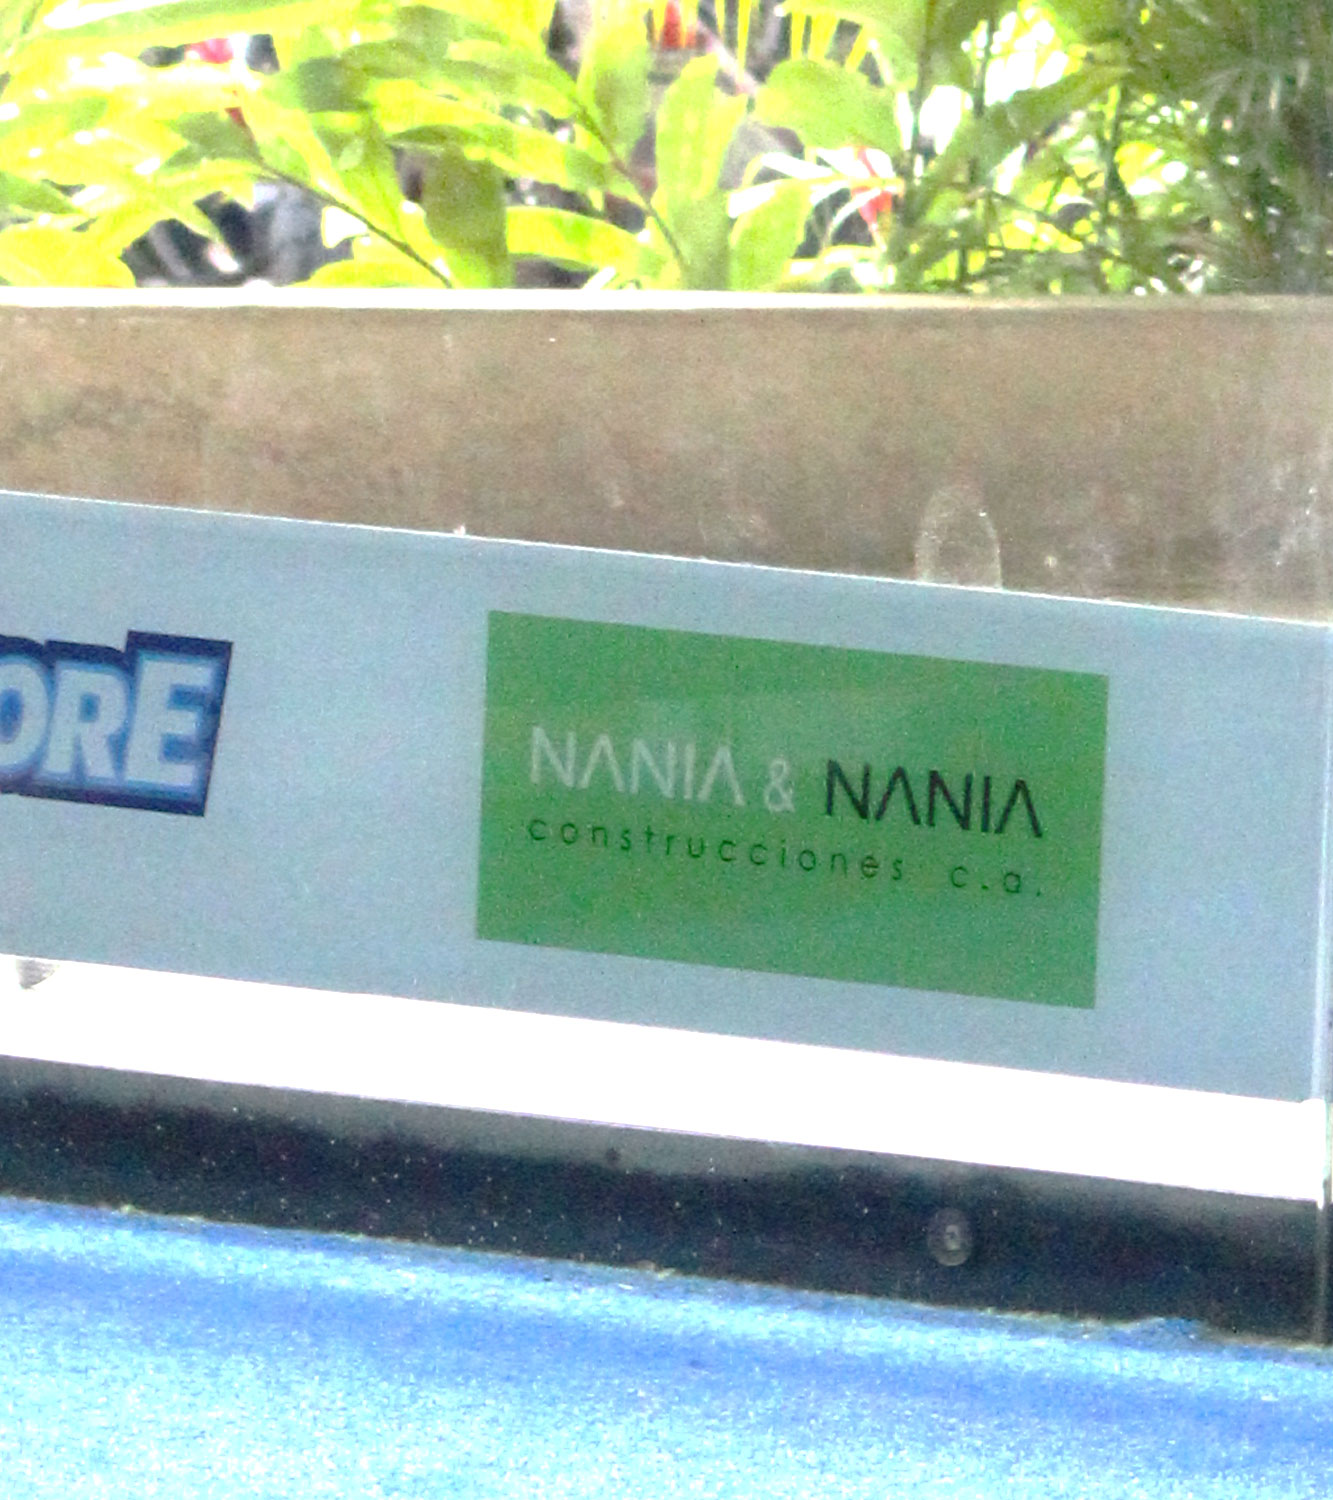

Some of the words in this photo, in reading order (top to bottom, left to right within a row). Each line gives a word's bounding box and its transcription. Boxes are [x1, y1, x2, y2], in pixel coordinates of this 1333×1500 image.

[530, 726, 745, 807] NANIA
[763, 757, 796, 812] &
[825, 759, 1044, 838] NANIA
[527, 817, 904, 881] construcciones
[950, 863, 1042, 897] c.a.
